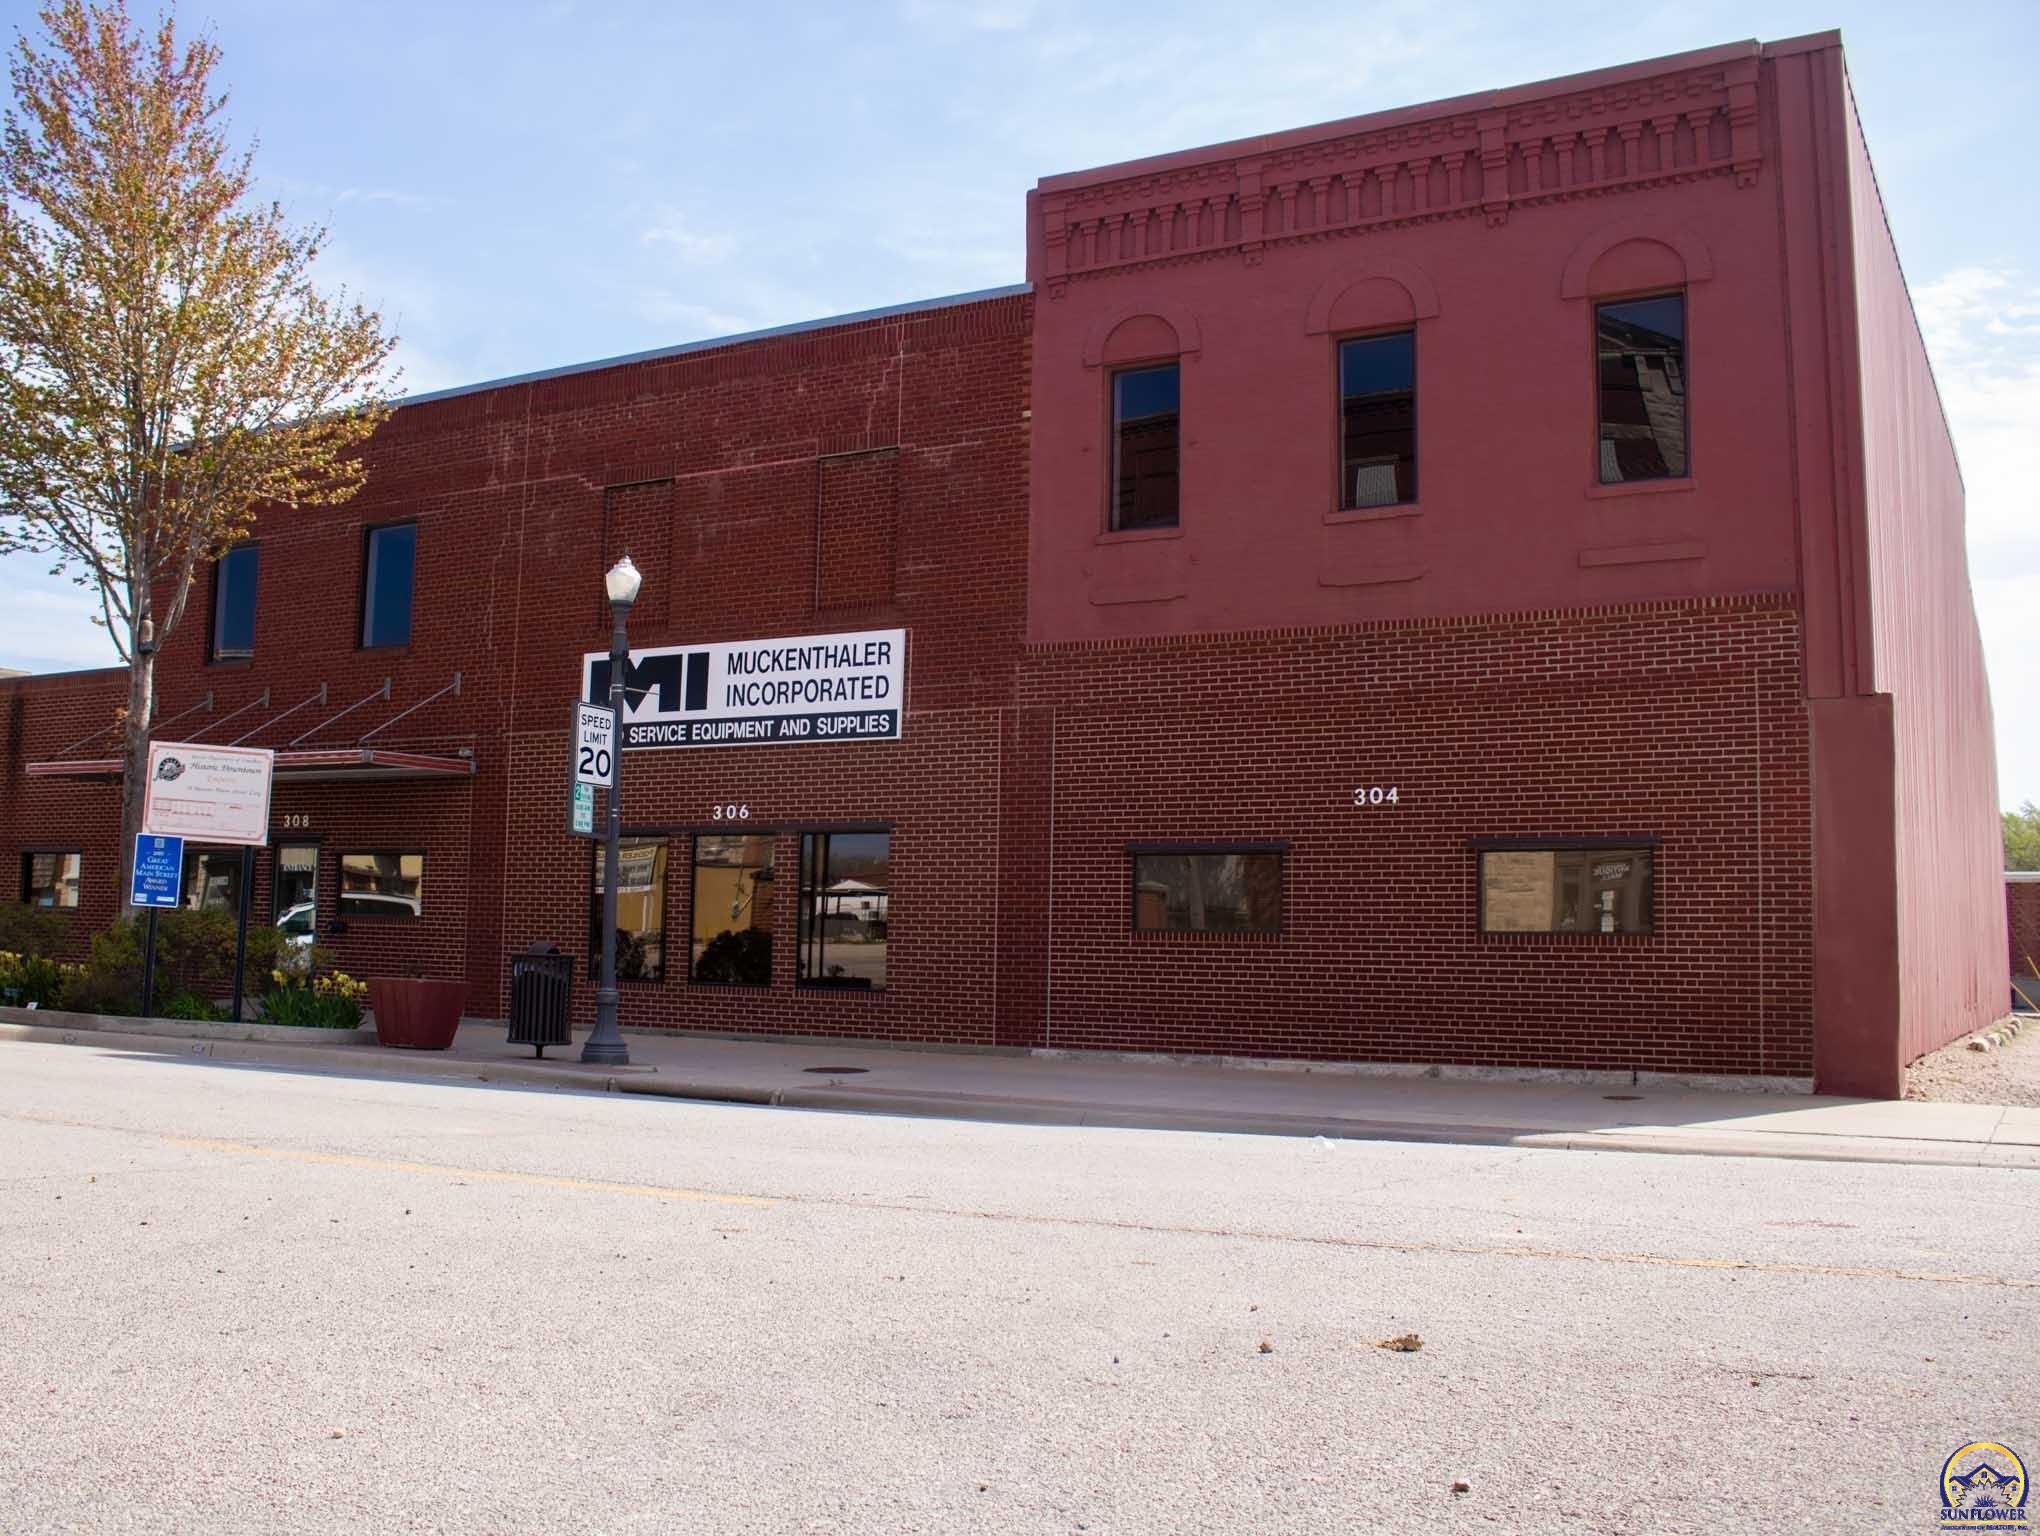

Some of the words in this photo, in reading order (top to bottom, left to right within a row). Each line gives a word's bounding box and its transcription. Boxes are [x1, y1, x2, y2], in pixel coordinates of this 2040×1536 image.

[727, 641, 891, 676] MUCKENTHALER
[726, 675, 890, 707] INCORPORATED
[581, 713, 612, 730] SPEED
[629, 724, 687, 743] SERVICE
[692, 719, 773, 741] EQUIPMENT
[779, 717, 810, 736] AND
[816, 714, 890, 735] SUPPLIES
[583, 730, 607, 746] LIMIT
[579, 746, 611, 778] 20
[1353, 787, 1400, 805] 304
[283, 814, 310, 828] 308
[712, 804, 749, 820] 306
